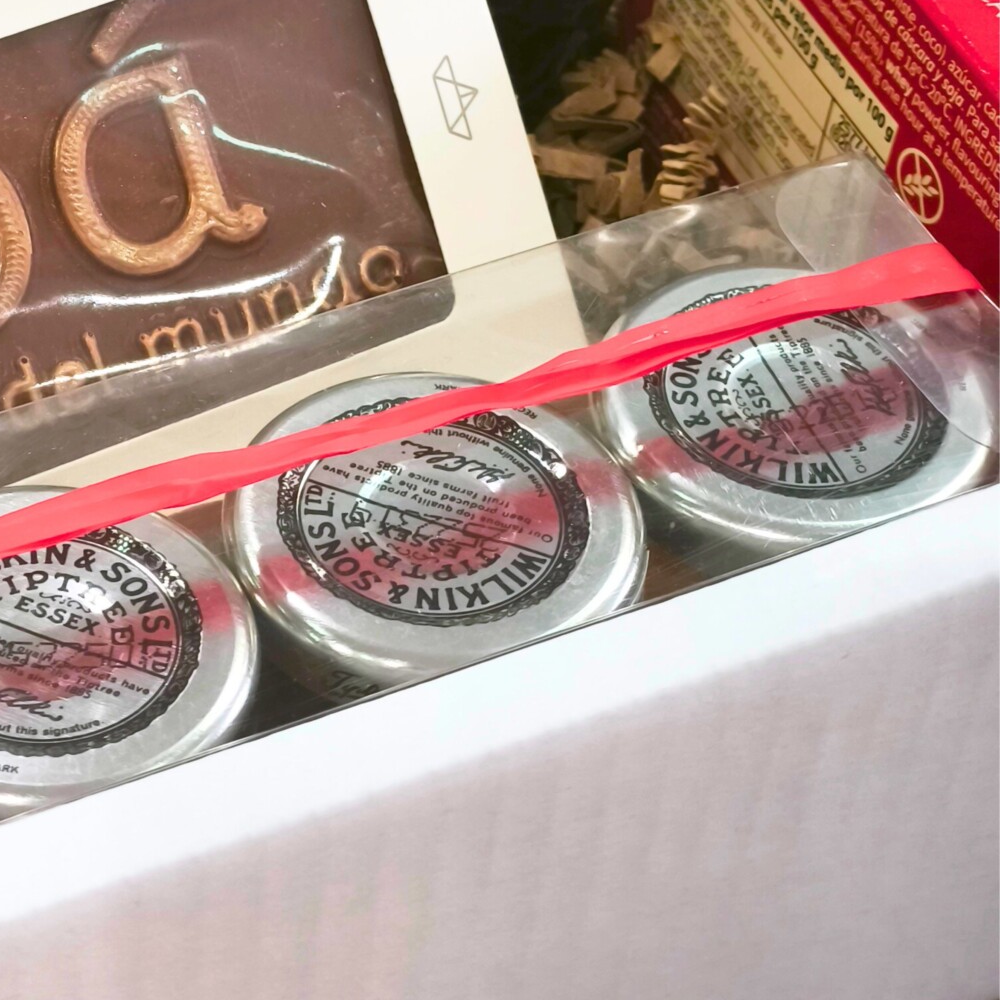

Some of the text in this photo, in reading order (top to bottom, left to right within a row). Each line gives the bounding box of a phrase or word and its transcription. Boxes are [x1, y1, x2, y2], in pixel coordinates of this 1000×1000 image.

[890, 38, 906, 61] de
[916, 23, 948, 62] coco),
[882, 57, 913, 98] whey
[885, 7, 899, 29] de
[897, 22, 936, 73] cáscara
[932, 67, 942, 84] y
[964, 104, 992, 138] Para
[844, 74, 864, 104] por
[864, 97, 885, 128] 100
[883, 125, 895, 144] g
[899, 97, 924, 134] hour
[933, 145, 943, 157] a
[138, 245, 402, 357] mundo
[767, 333, 798, 373] products
[796, 335, 815, 358] 1885
[796, 360, 811, 376] the
[808, 375, 821, 388] on
[669, 348, 841, 484] WILKIN & SON
[446, 428, 489, 447] without
[895, 424, 910, 445] None
[321, 463, 350, 478] have
[492, 445, 530, 473] genuine
[847, 453, 867, 475] Our
[348, 460, 393, 484] Tptree
[375, 459, 509, 509] fruit farms since 1885
[353, 473, 407, 498] prodcts
[397, 479, 418, 492] the
[422, 487, 437, 497] on
[527, 473, 546, 497] None
[410, 492, 453, 513] quality
[441, 492, 497, 515] produced
[455, 507, 475, 520] top
[344, 510, 501, 582] TIPTREE
[527, 528, 553, 543] Our
[307, 525, 382, 592] SONS
[74, 550, 97, 572] &
[100, 562, 171, 633] SONS
[387, 581, 409, 604] &
[416, 551, 548, 610] WILKIN
[14, 597, 101, 636] ESSEX
[121, 679, 150, 695] have
[16, 726, 37, 734] this
